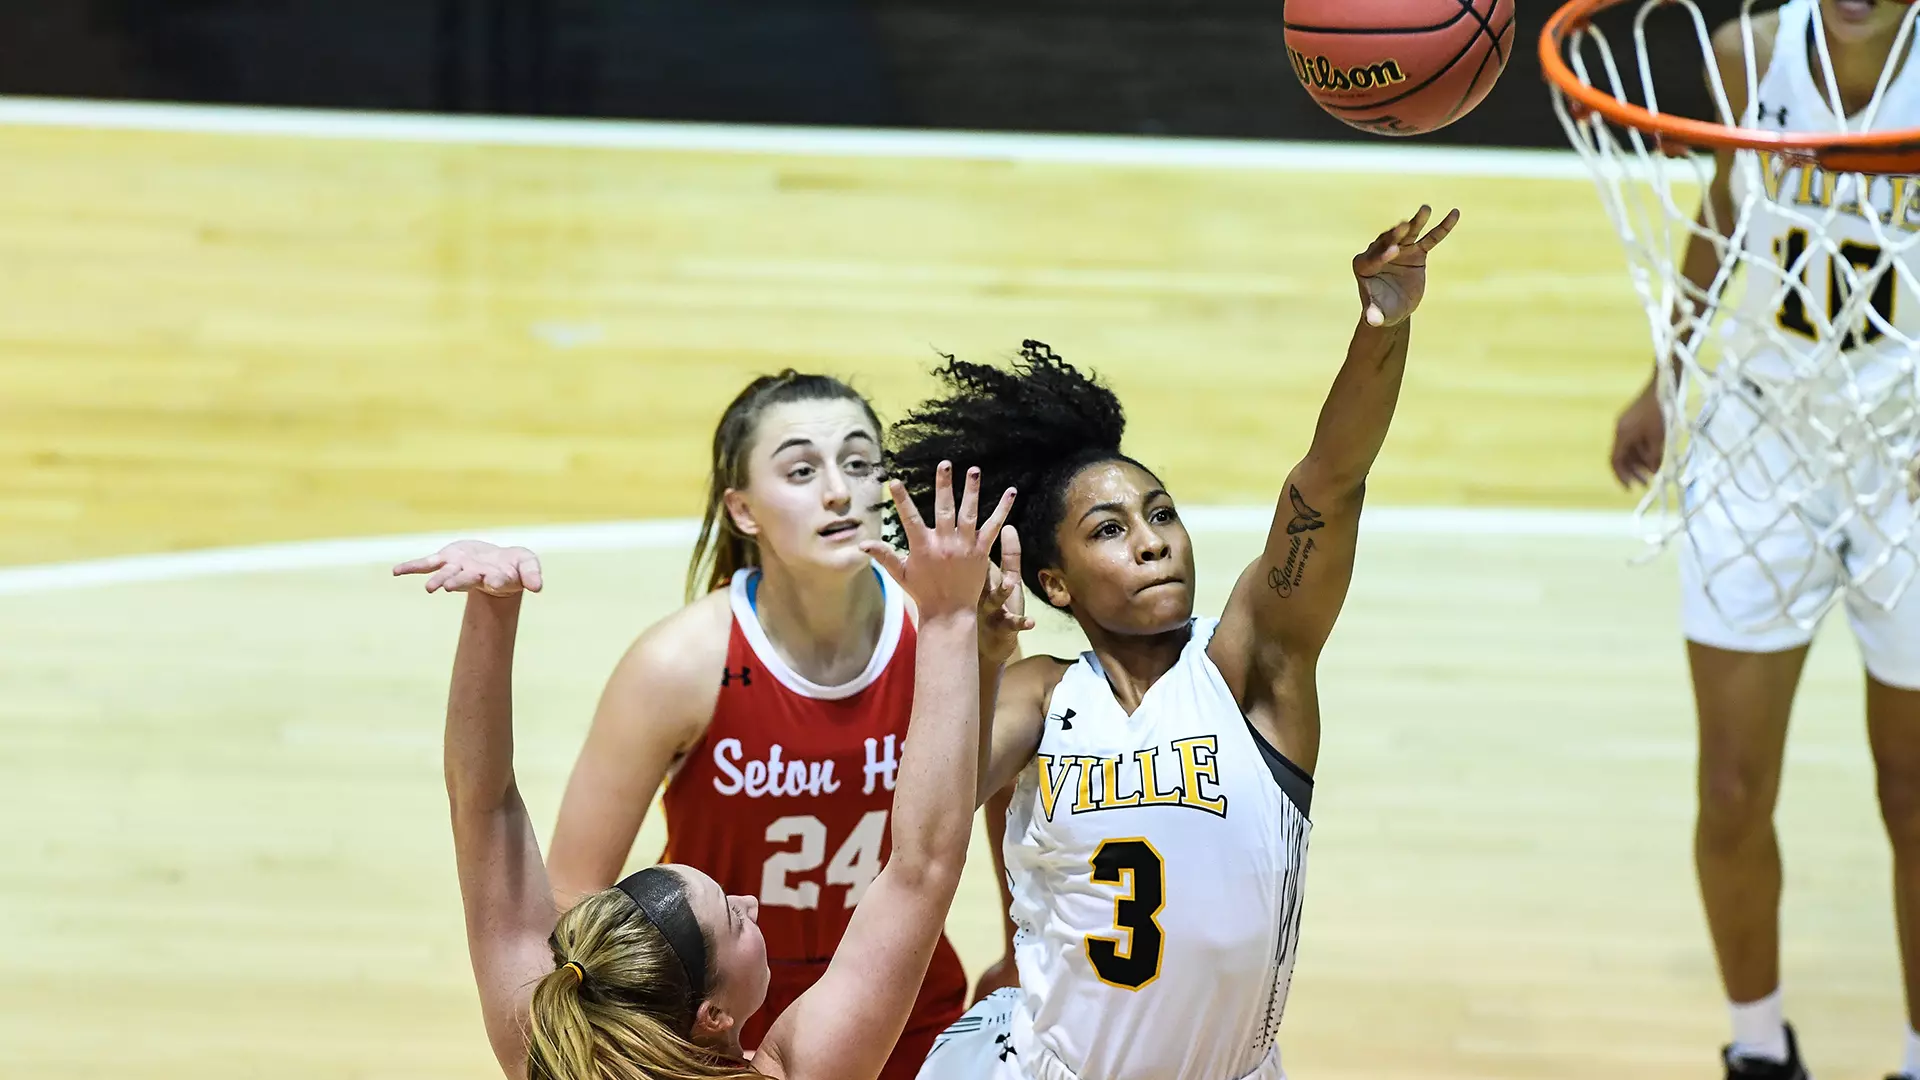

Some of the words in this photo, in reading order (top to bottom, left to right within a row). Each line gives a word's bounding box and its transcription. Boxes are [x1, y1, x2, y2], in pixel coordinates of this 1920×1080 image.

[1771, 226, 1897, 352] 10
[713, 738, 841, 797] Seton
[1037, 734, 1228, 823] VILLE
[760, 809, 889, 911] 24
[1084, 836, 1166, 992] 3
